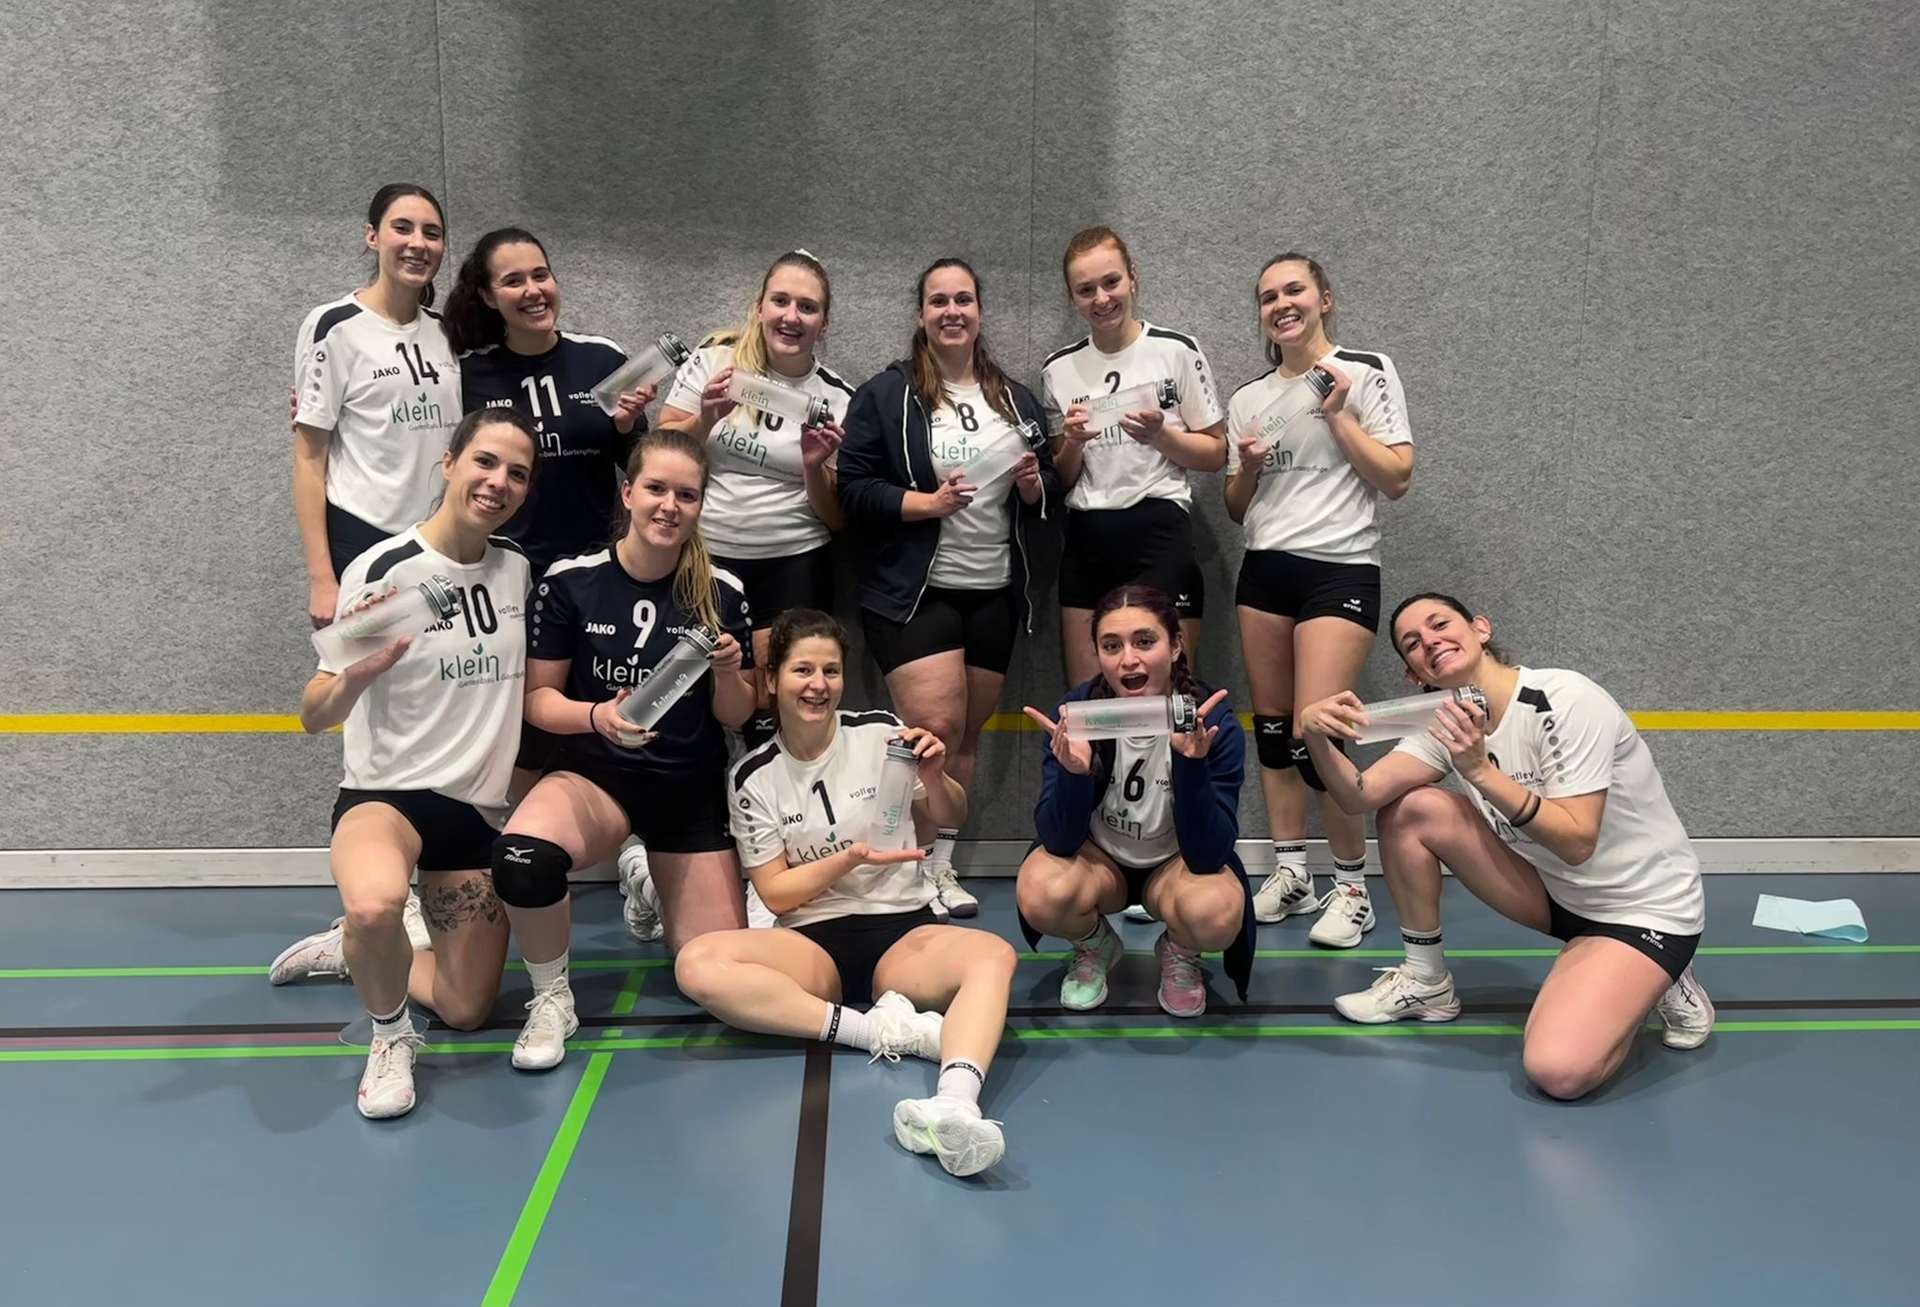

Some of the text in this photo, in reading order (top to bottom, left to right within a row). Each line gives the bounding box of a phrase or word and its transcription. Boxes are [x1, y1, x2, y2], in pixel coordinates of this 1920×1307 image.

[372, 366, 401, 380] JAKO
[395, 342, 440, 386] 14
[390, 392, 443, 429] klein
[485, 398, 513, 409] JAKO
[520, 375, 562, 418] 11
[957, 402, 980, 433] 8
[1257, 416, 1287, 440] klein
[716, 424, 768, 468] klein
[1264, 440, 1294, 470] ein
[459, 583, 499, 638] 10
[632, 599, 657, 649] 9
[585, 622, 617, 636] JAKO
[666, 625, 691, 635] volle
[440, 642, 500, 682] klein
[592, 653, 652, 684] klein
[1123, 758, 1146, 803] 6
[1508, 771, 1535, 781] olley
[812, 778, 837, 826] 1
[849, 786, 877, 799] volley
[882, 804, 903, 838] klein
[1101, 808, 1142, 841] lein
[1640, 933, 1665, 950] erima
